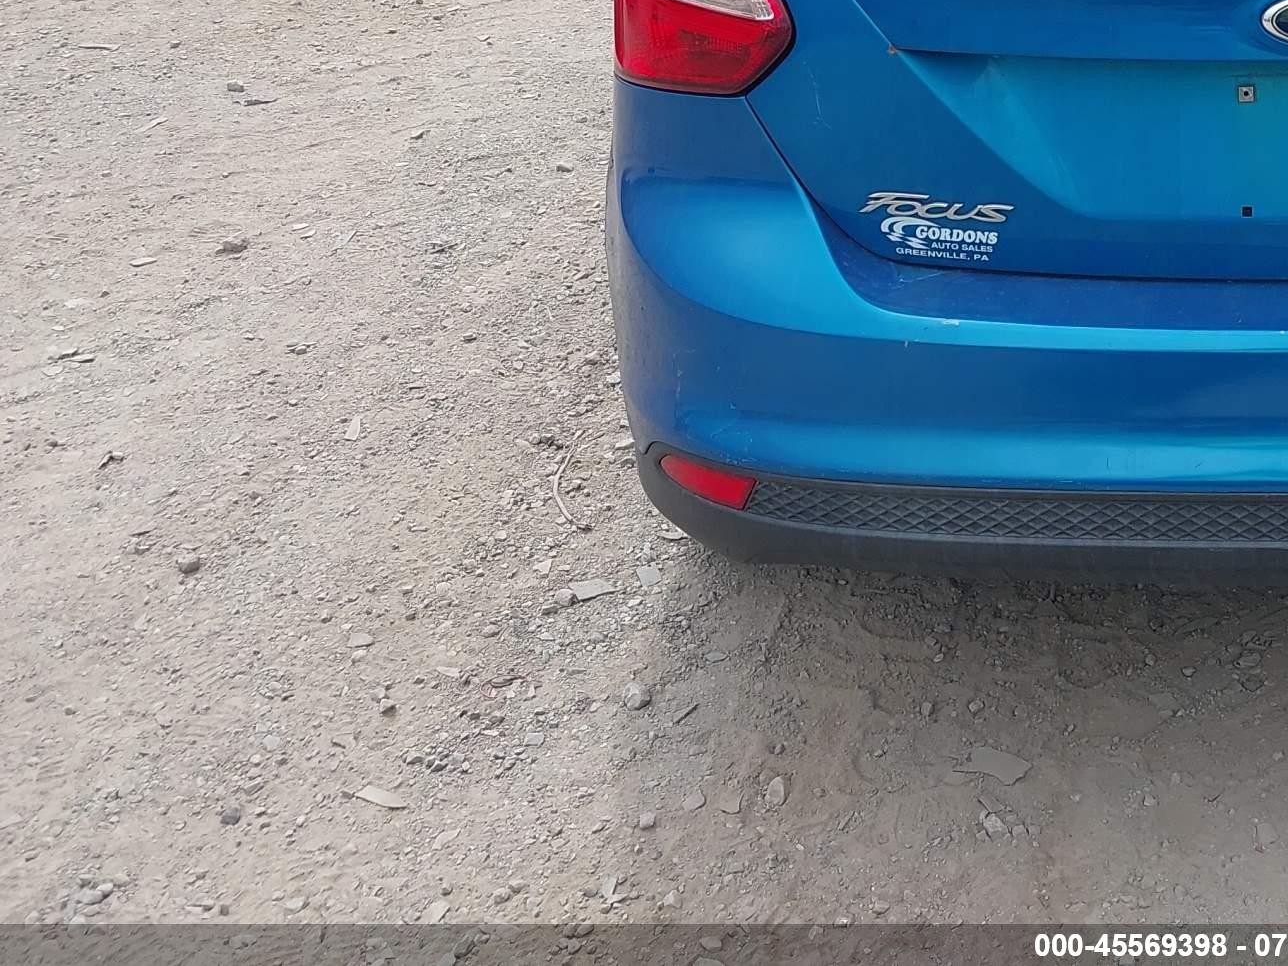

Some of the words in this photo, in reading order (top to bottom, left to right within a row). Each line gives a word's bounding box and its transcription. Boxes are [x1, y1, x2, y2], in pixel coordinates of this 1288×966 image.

[915, 224, 999, 245] GORDONS
[895, 246, 971, 261] GREENVILLE,
[974, 253, 989, 262] PA
[931, 241, 959, 251] AUTO
[961, 243, 993, 253] SALES
